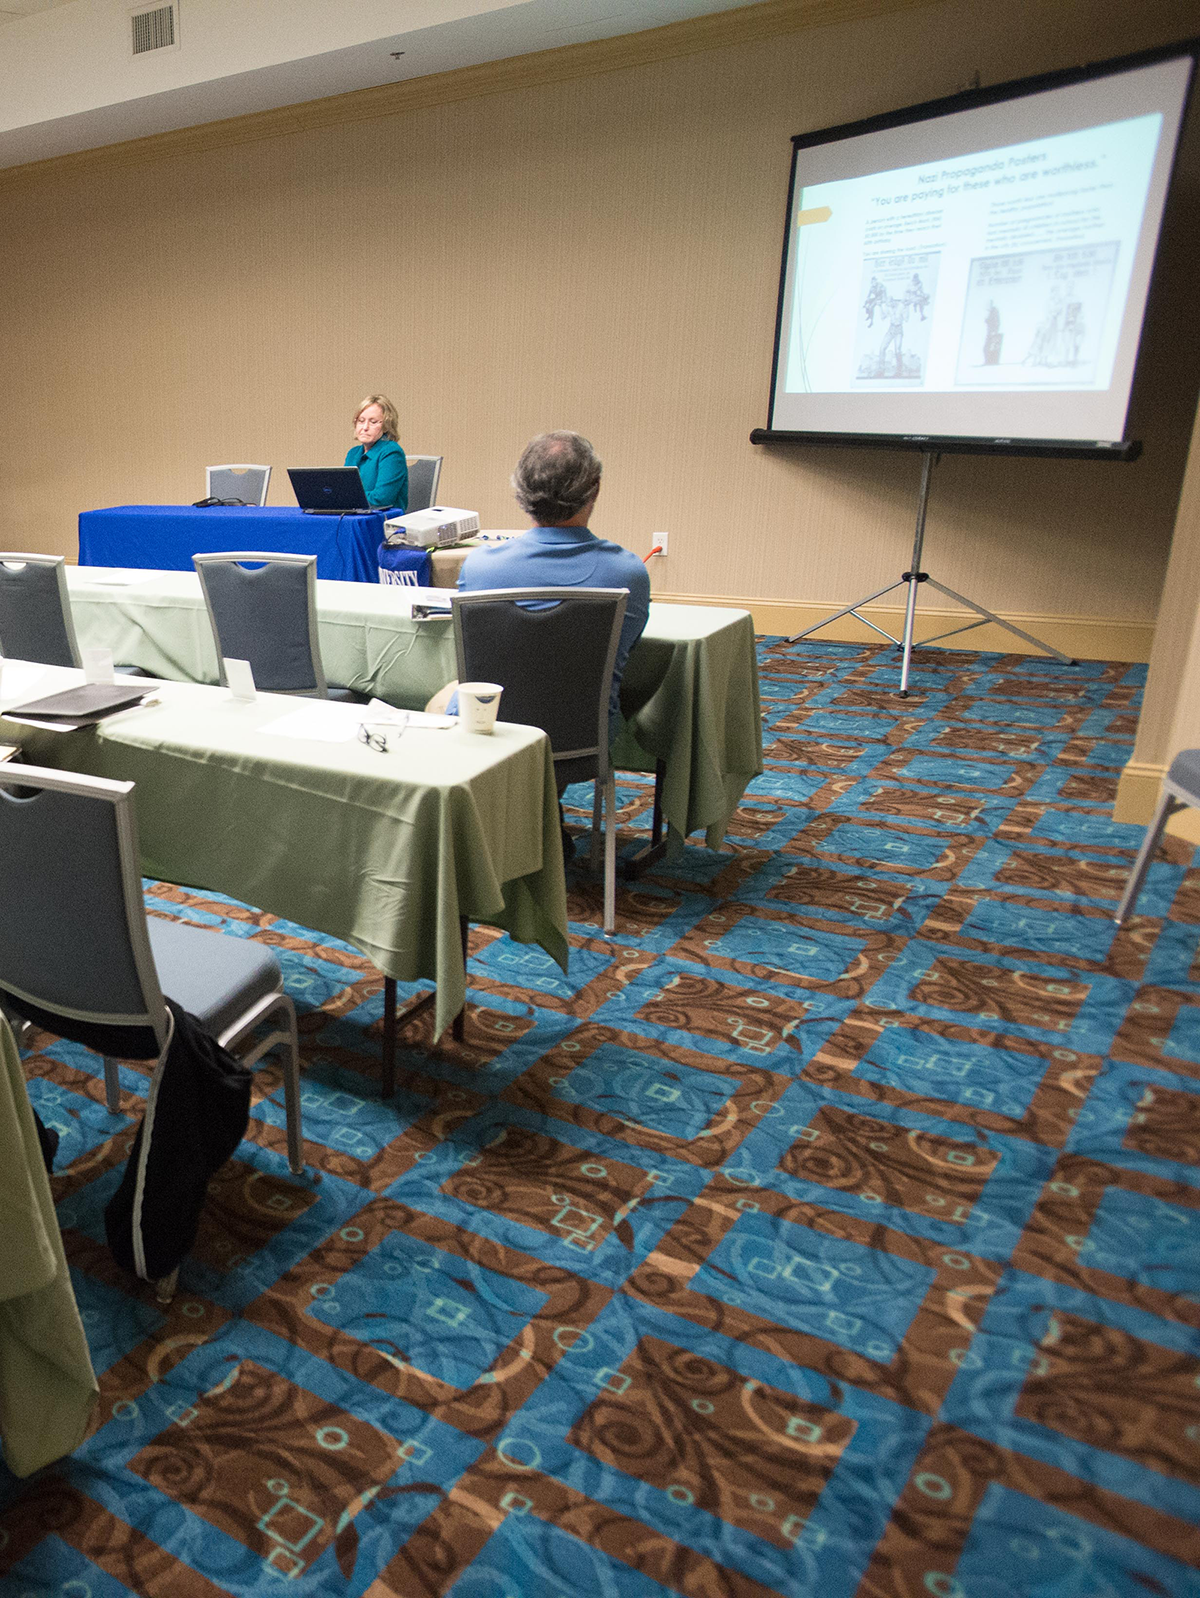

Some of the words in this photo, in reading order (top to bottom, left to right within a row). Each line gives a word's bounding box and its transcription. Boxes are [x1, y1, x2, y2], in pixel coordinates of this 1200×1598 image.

[918, 171, 938, 185] Nazi
[941, 160, 1005, 181] Propaganda
[1008, 152, 1047, 168] Posters
[894, 195, 909, 204] are
[911, 188, 944, 202] paying
[947, 183, 960, 195] for
[994, 173, 1016, 186] who
[1020, 171, 1038, 182] are
